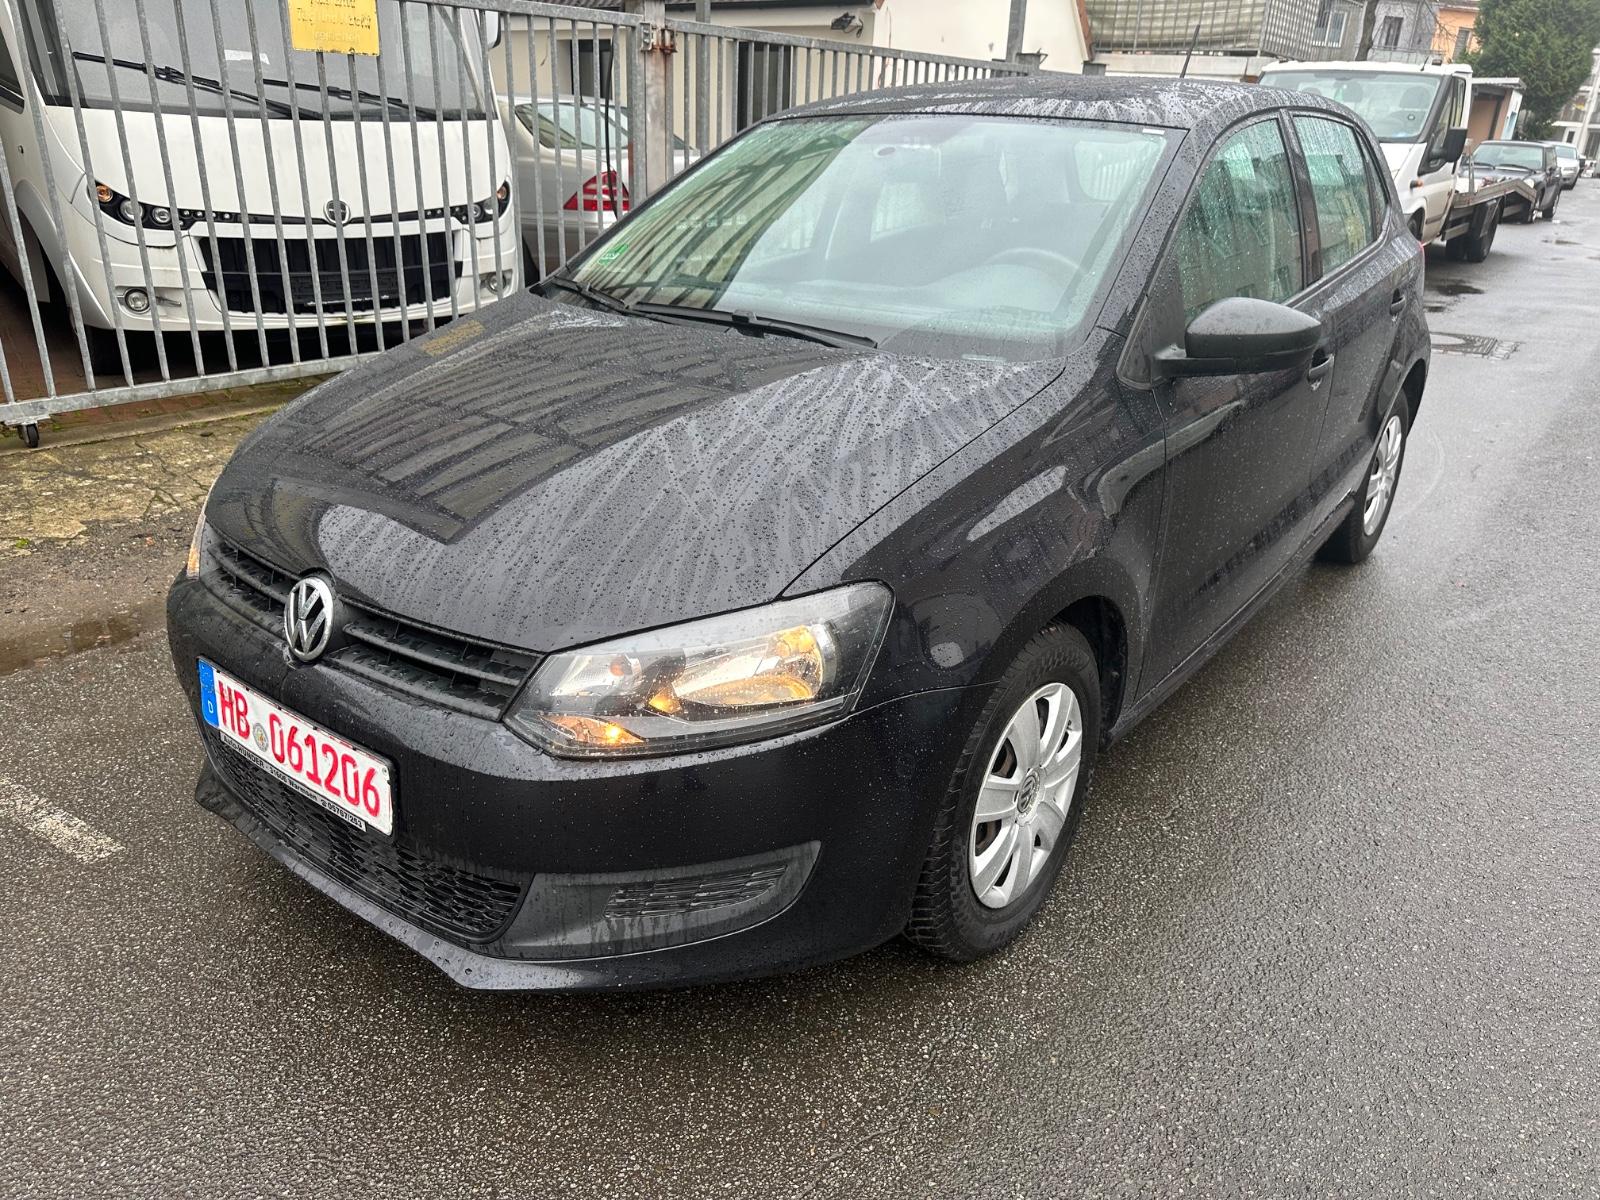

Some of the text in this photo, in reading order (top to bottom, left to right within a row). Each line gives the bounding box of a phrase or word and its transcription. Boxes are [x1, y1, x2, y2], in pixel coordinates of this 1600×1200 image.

[207, 699, 214, 714] D
[218, 679, 381, 818] HB 061206
